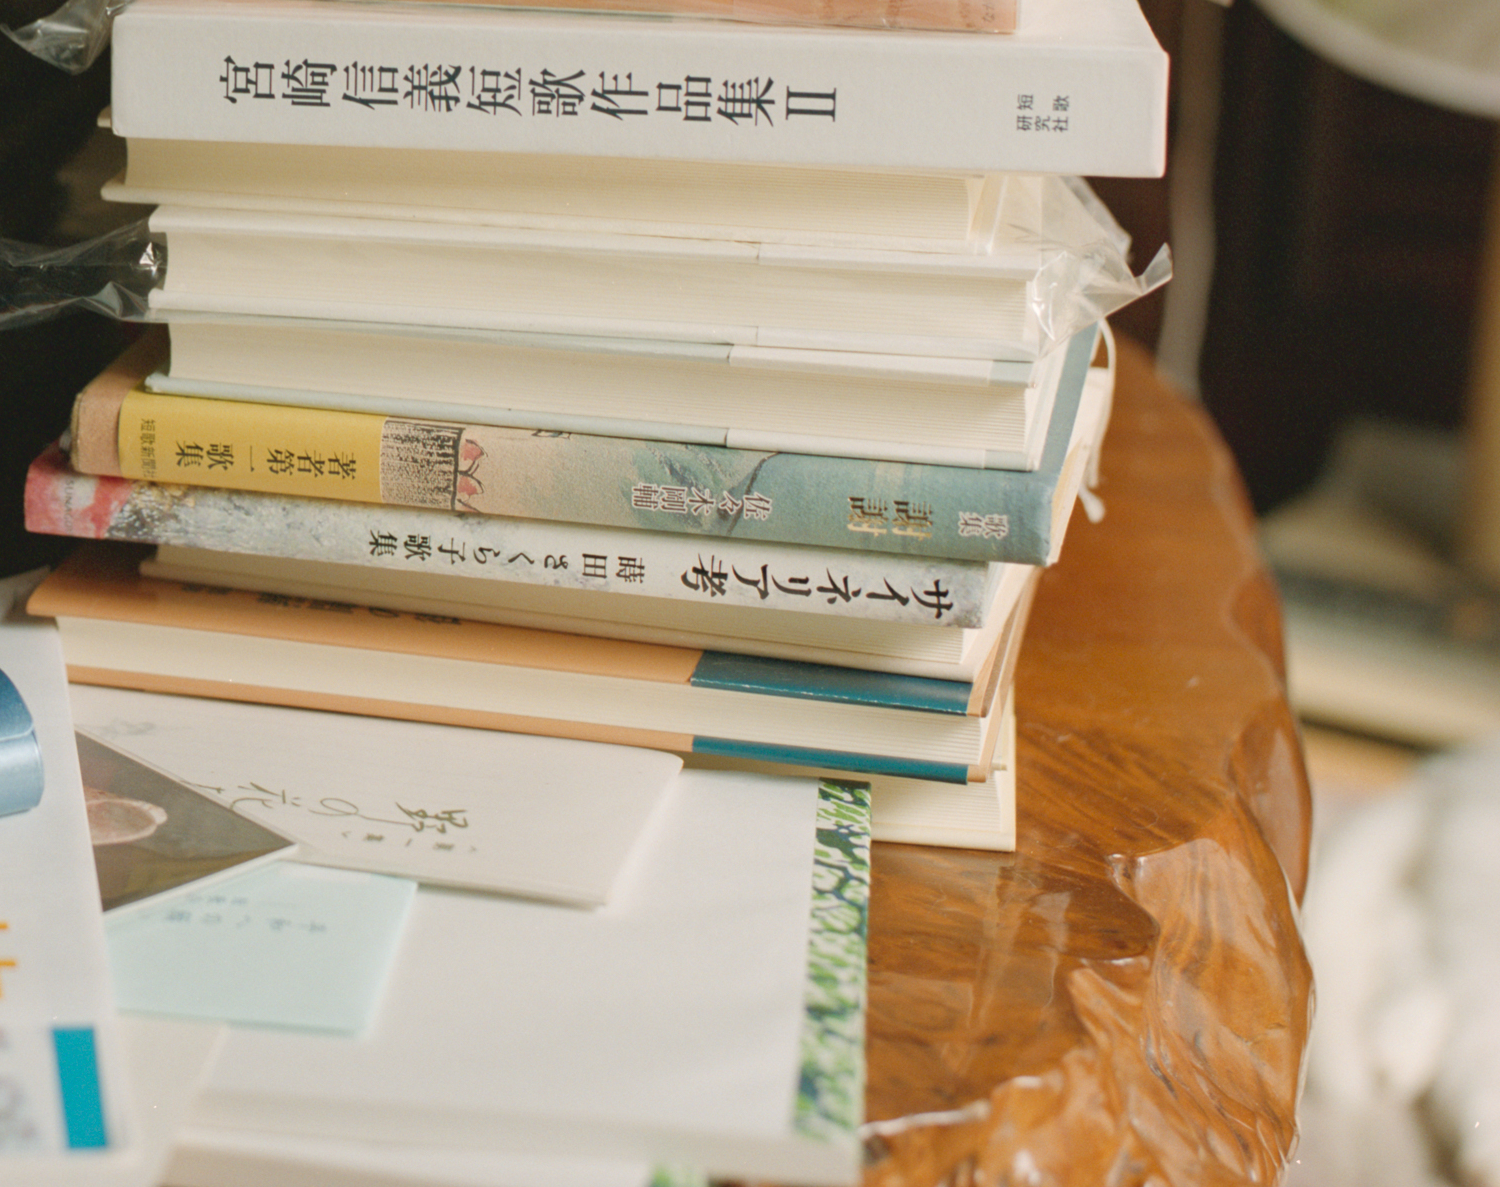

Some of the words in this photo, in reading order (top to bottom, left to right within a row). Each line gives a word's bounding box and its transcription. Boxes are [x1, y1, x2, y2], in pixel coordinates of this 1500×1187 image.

[139, 418, 157, 480] 短歌新聞社
[175, 438, 357, 481] 著者第一歌集
[632, 483, 772, 521] 佐々木剛輔
[957, 512, 1010, 539] 歌集
[368, 529, 646, 584] 蒔田さくら子歌集
[681, 553, 953, 620] サイネリア考
